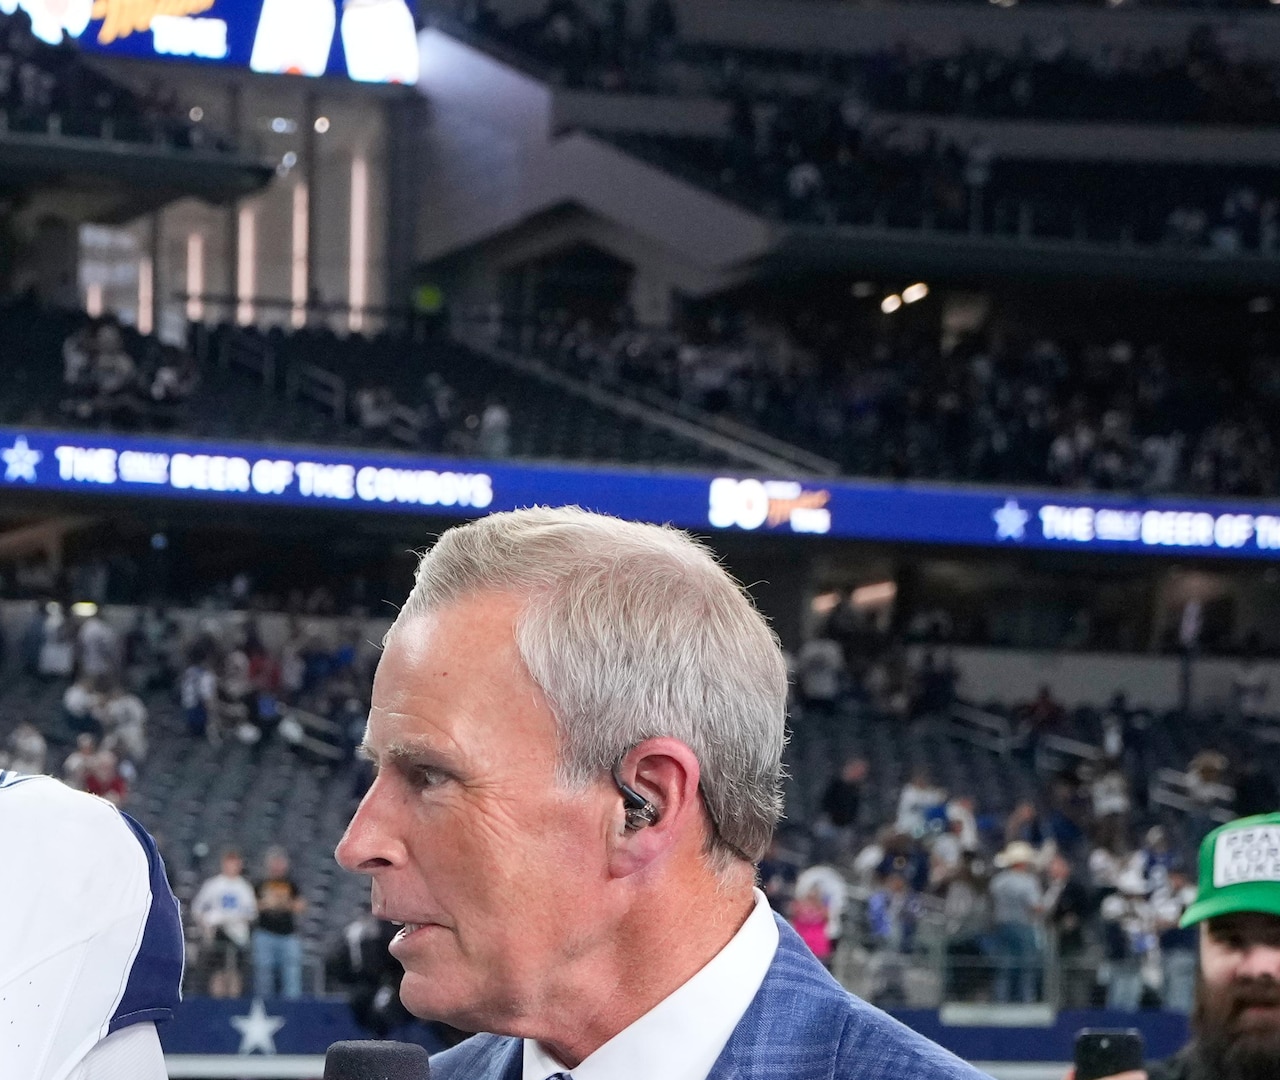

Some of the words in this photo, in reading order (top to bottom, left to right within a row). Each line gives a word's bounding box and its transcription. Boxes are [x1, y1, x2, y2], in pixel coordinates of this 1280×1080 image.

[55, 446, 117, 483] THE
[170, 453, 250, 492] BEER
[252, 459, 294, 494] OF
[295, 462, 355, 499] THE
[356, 466, 493, 508] COWBOYS
[1040, 505, 1094, 541] THE
[1141, 510, 1214, 546] BEER
[1214, 513, 1253, 548] OF
